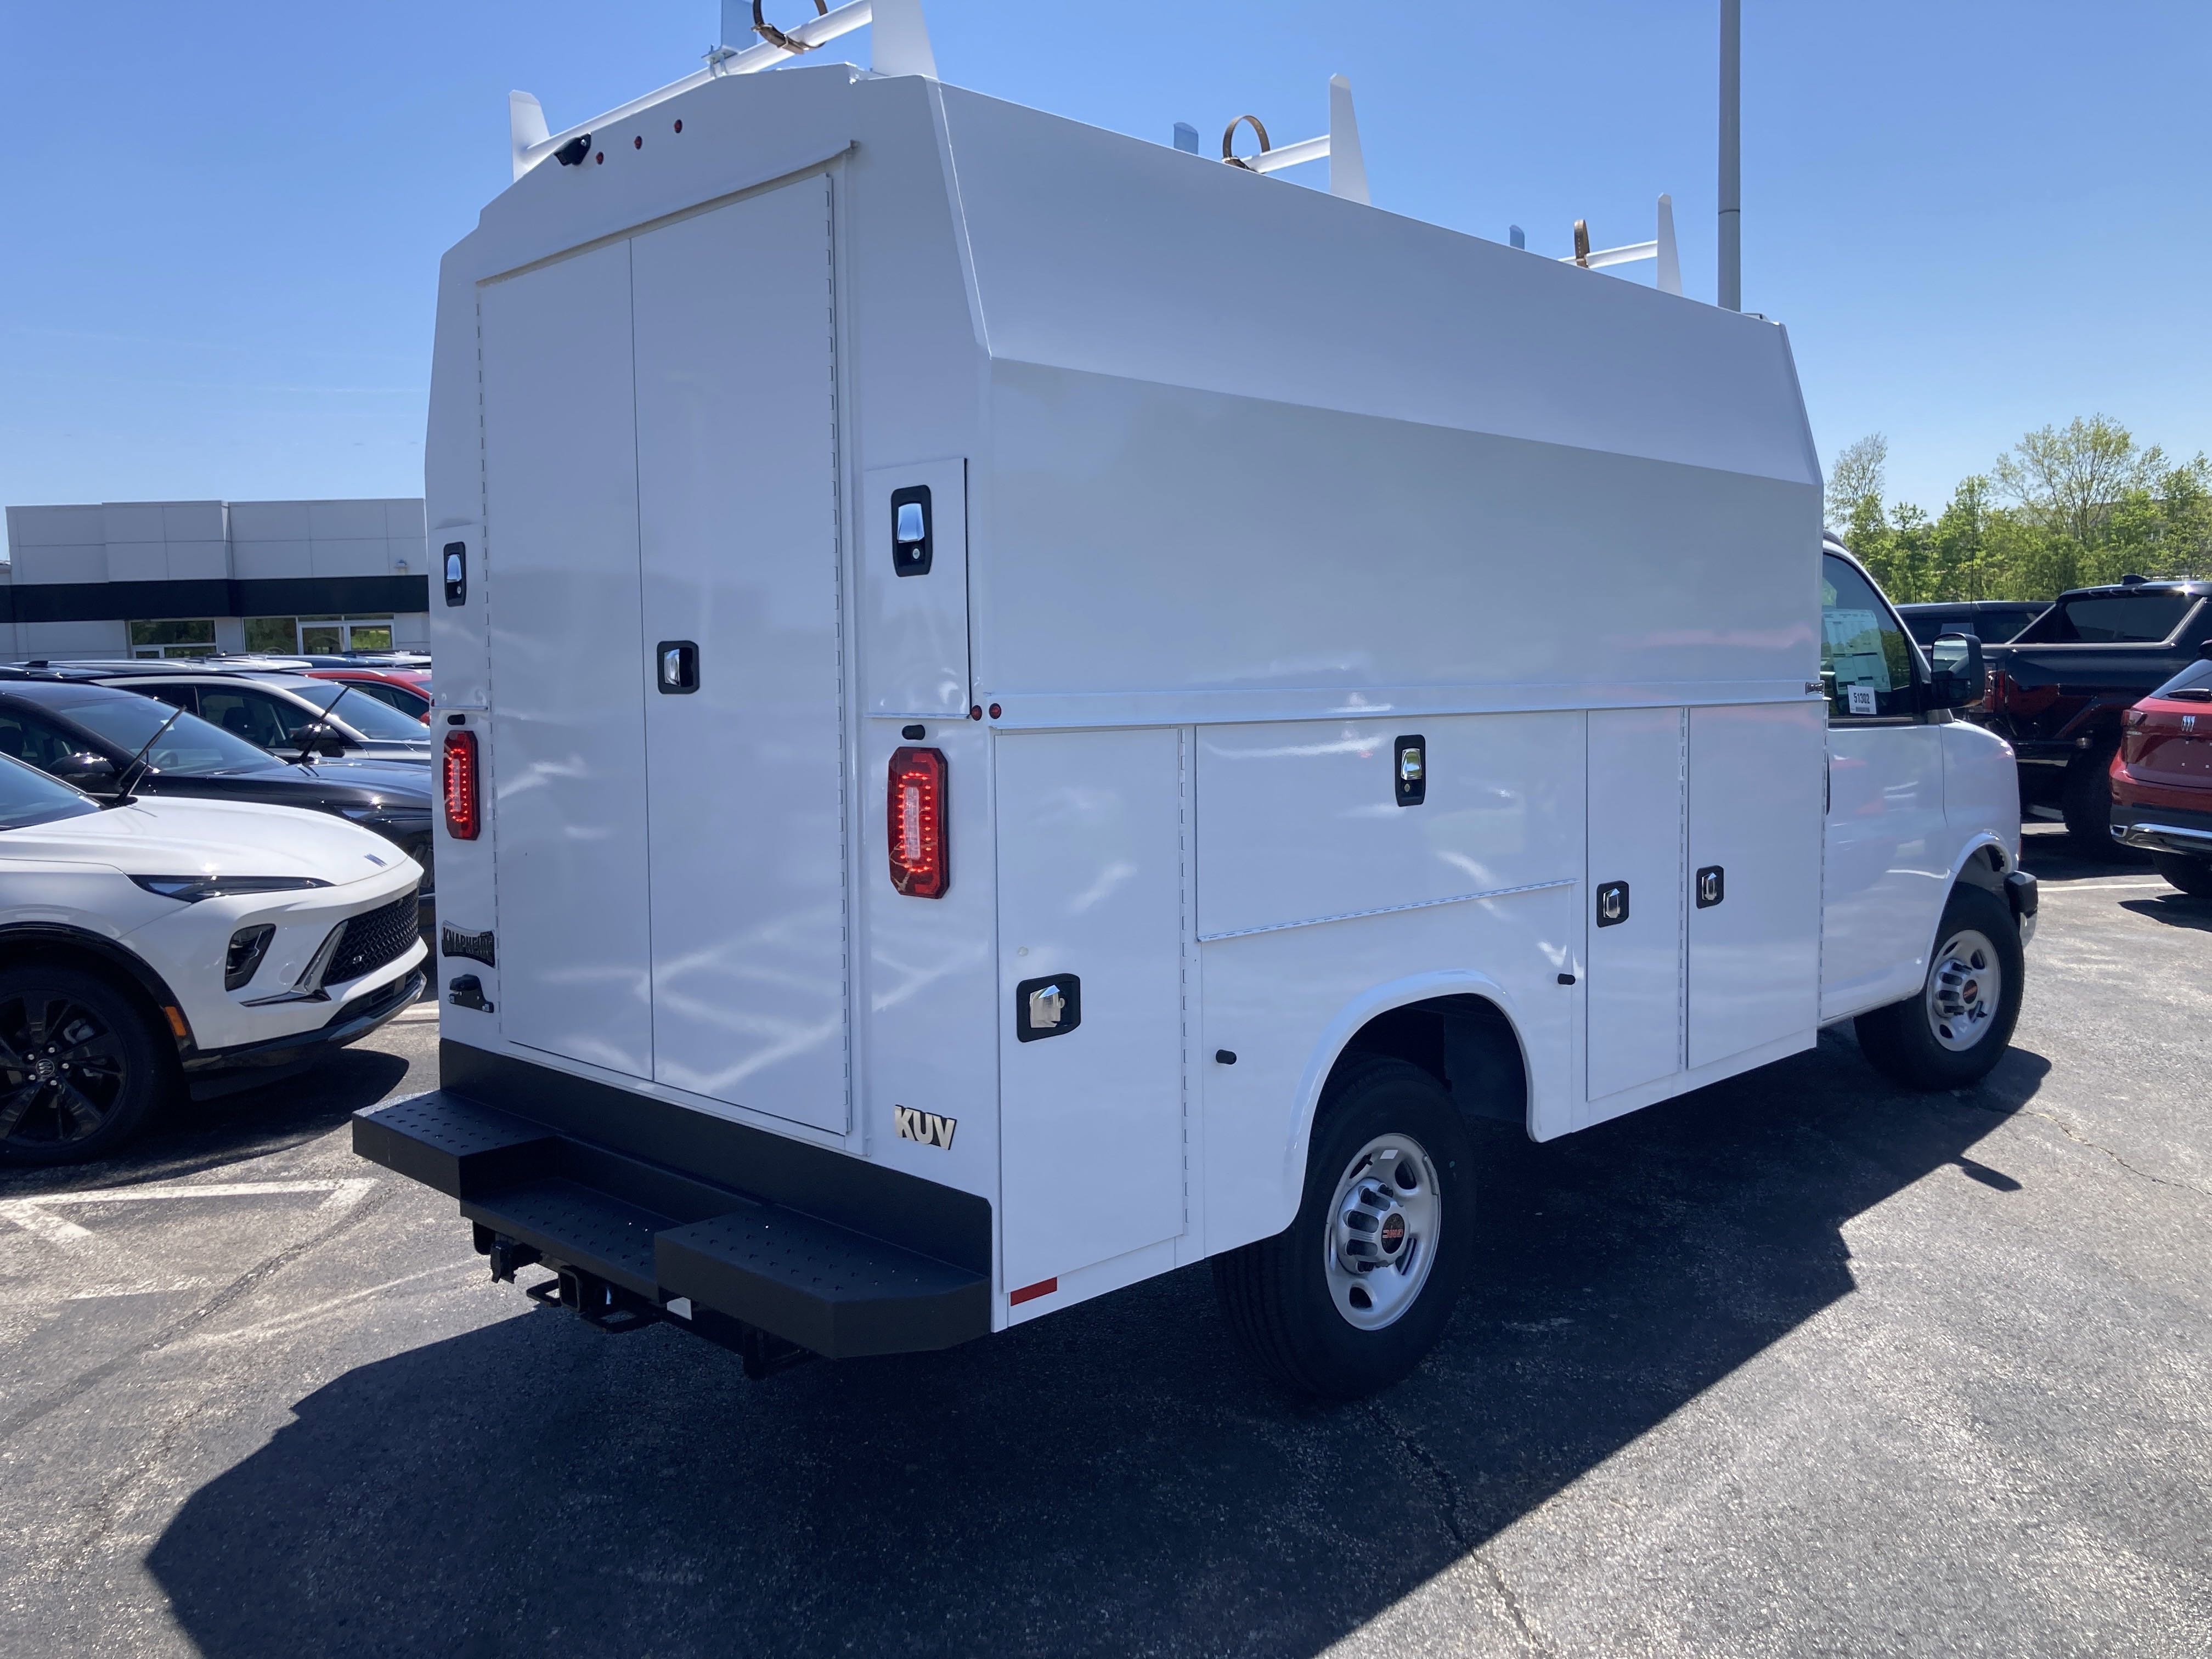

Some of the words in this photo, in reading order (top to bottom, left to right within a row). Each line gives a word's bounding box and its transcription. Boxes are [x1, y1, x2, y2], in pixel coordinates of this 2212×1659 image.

[1853, 692, 1870, 704] 51302
[895, 1104, 957, 1150] KUV
[1381, 1229, 1403, 1238] GMC
